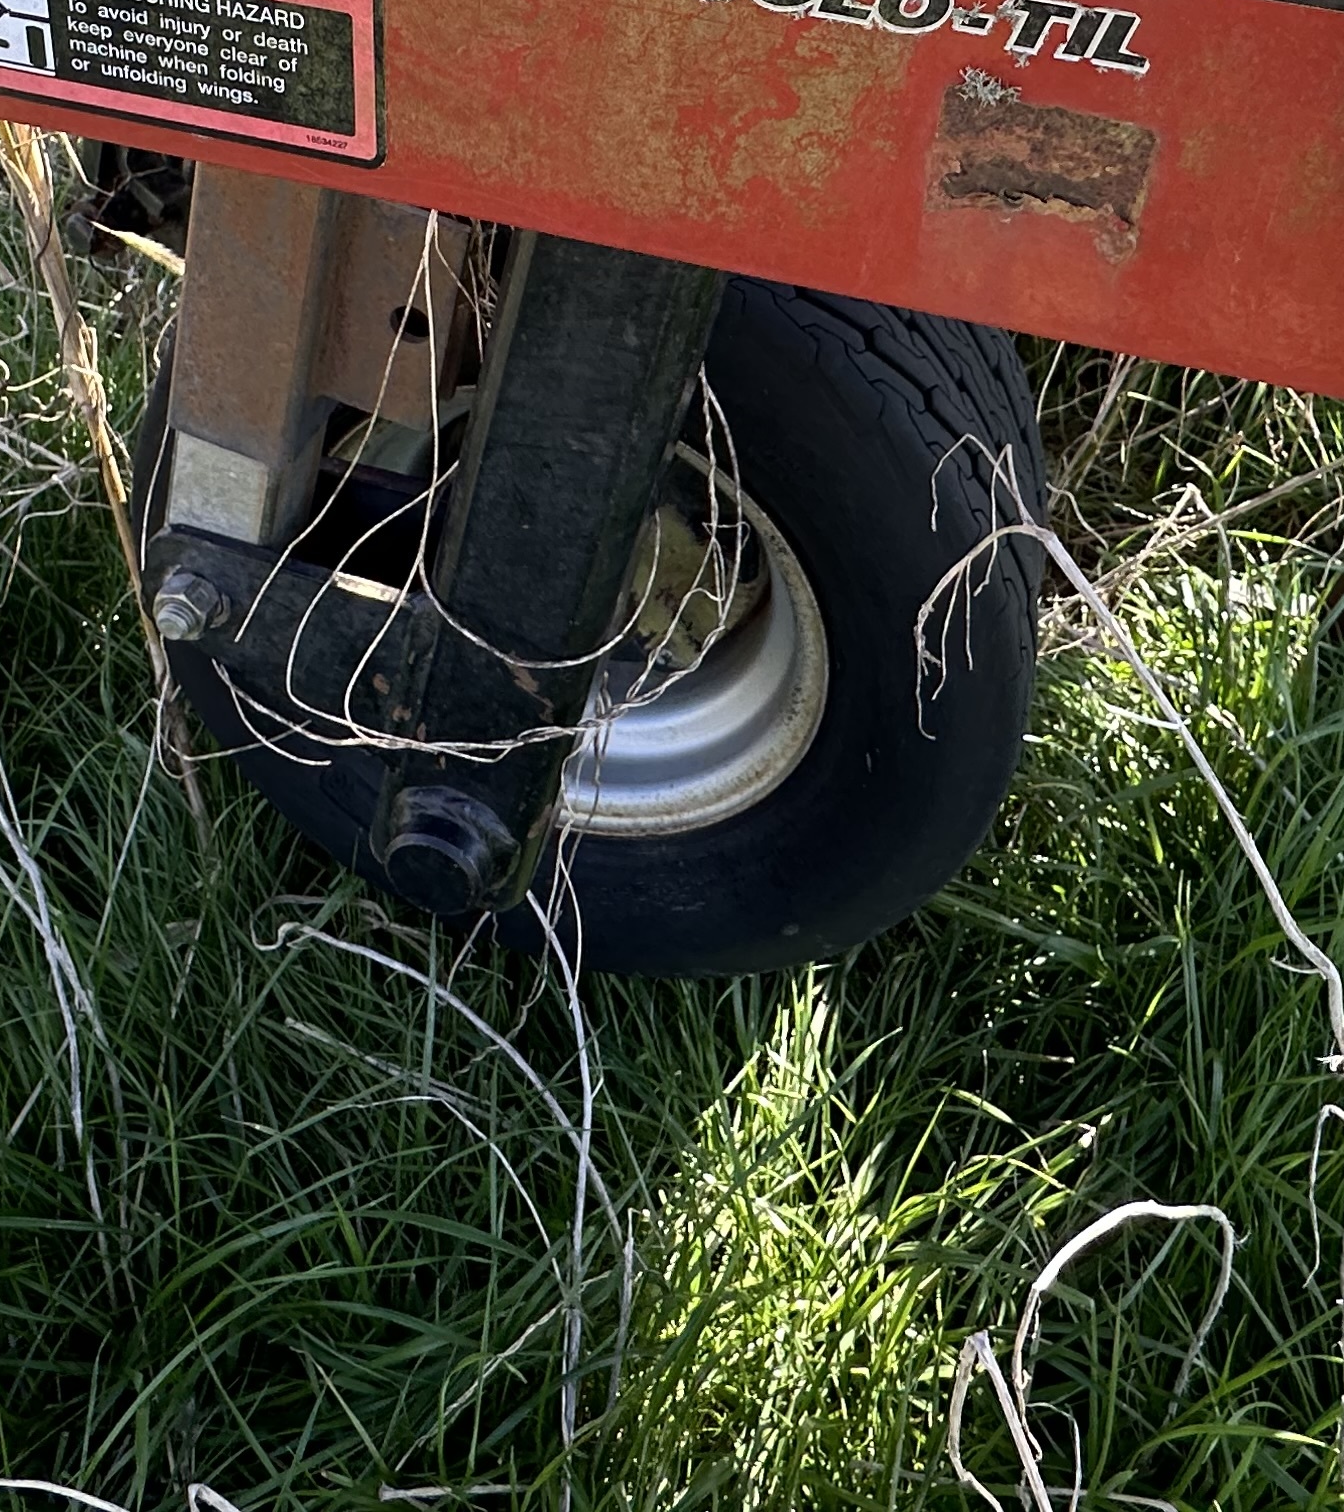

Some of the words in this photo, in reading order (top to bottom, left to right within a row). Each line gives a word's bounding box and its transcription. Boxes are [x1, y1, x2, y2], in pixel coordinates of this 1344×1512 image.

[67, 16, 113, 41] keep
[123, 29, 209, 57] everyone
[220, 44, 267, 68] clear
[278, 56, 299, 73] of
[97, 2, 149, 26] avoid
[159, 13, 211, 40] injury
[221, 28, 242, 44] or
[253, 30, 309, 56] death
[69, 39, 148, 64] machine
[158, 55, 209, 76] when
[219, 64, 286, 93] folding
[71, 57, 90, 72] or
[101, 63, 187, 93] unfolding
[198, 82, 259, 105] wings.
